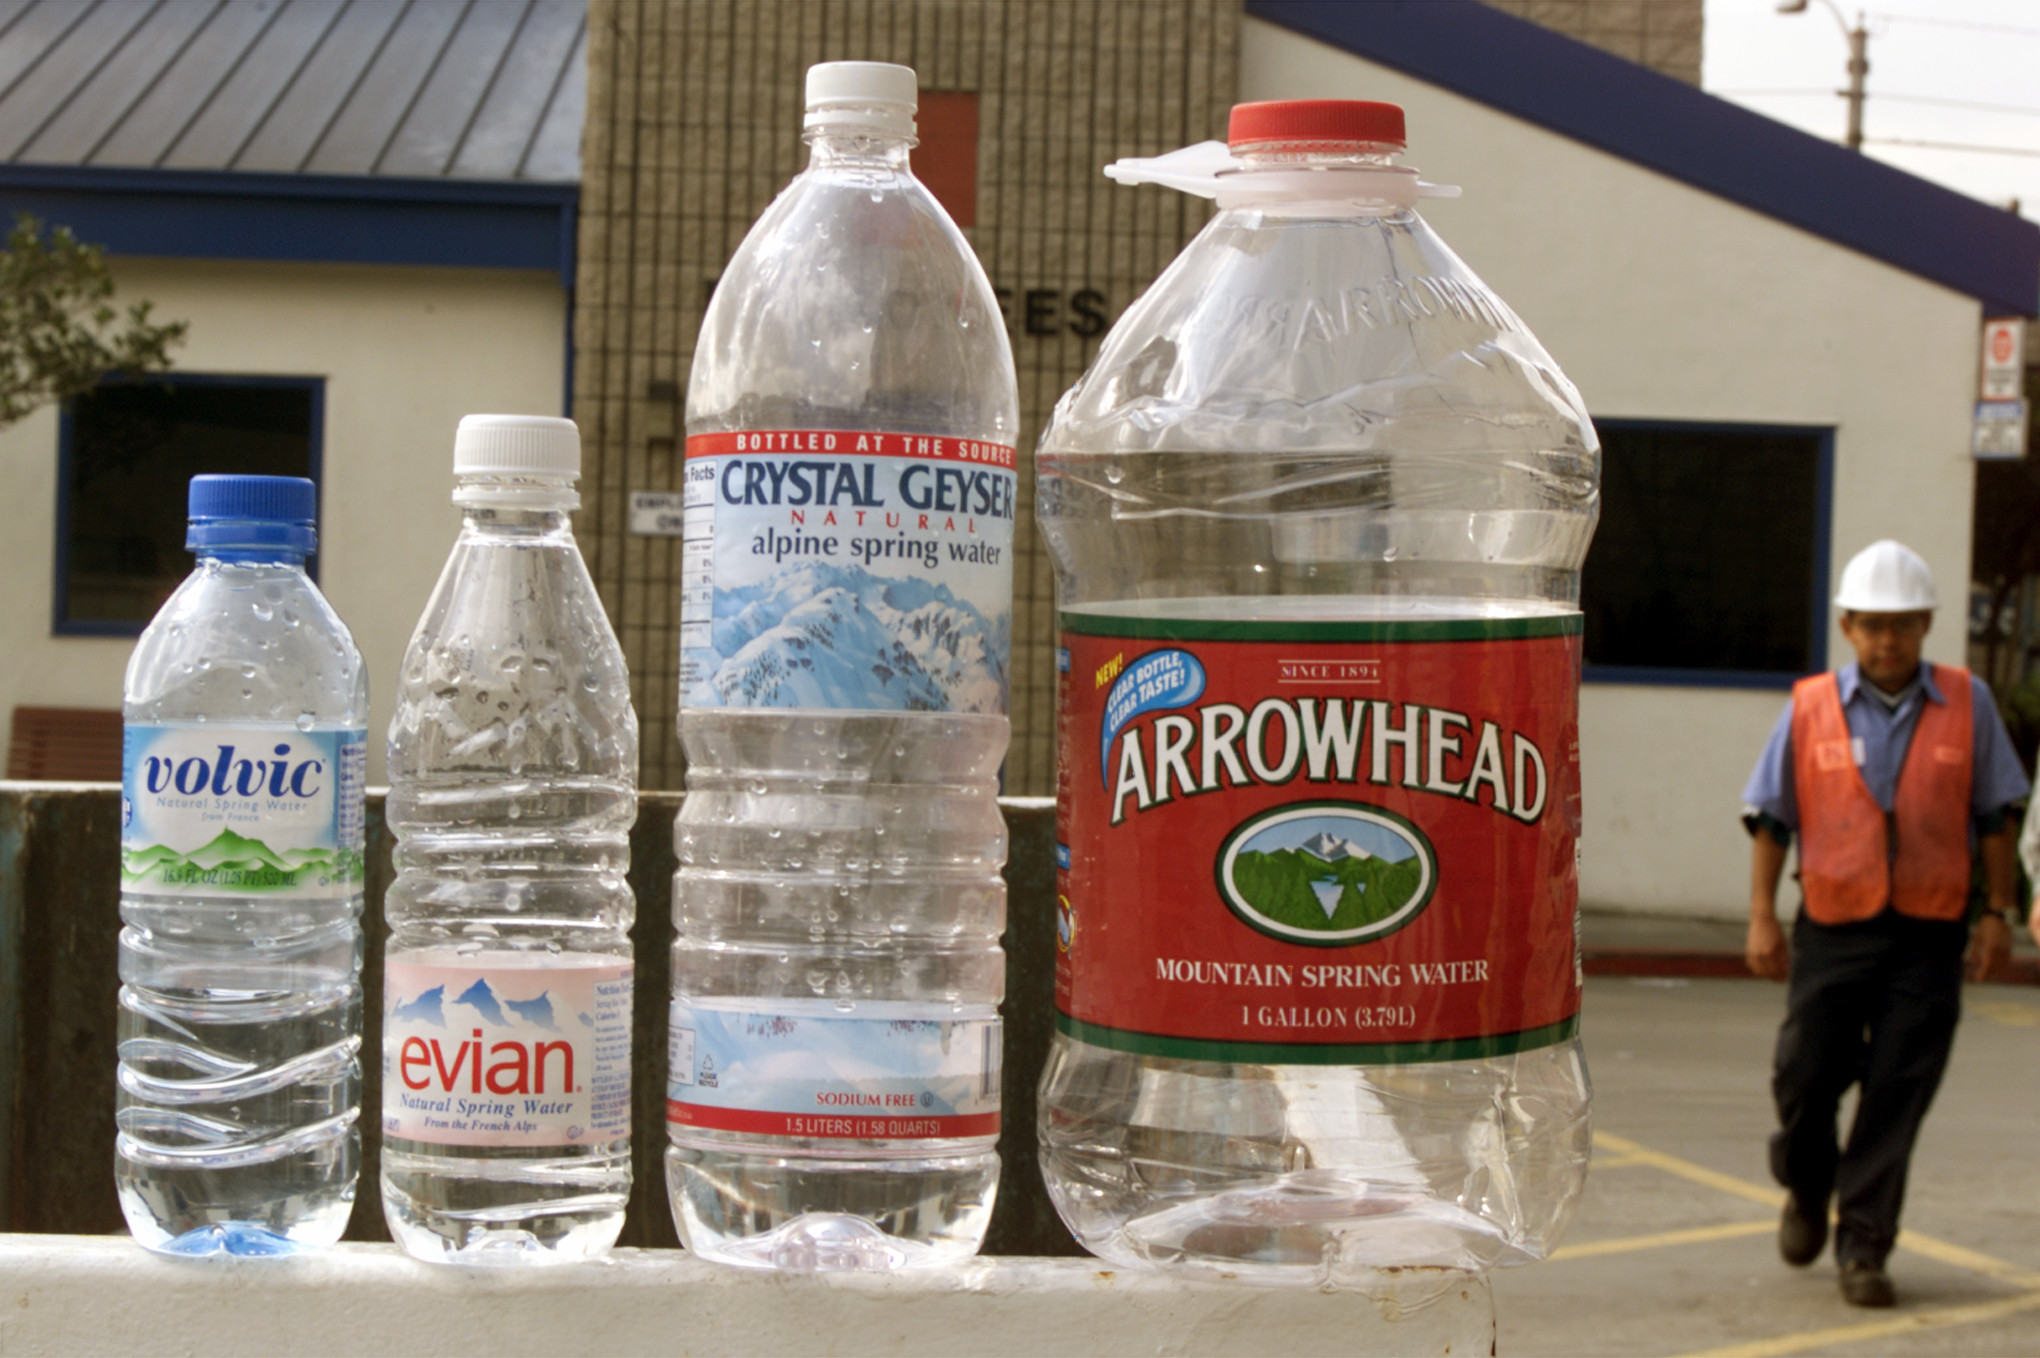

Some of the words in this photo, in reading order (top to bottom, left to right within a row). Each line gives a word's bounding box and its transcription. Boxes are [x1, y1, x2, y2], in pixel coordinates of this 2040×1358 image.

[736, 433, 837, 450] BOTTLED
[857, 435, 885, 452] AT
[903, 437, 943, 456] THE
[959, 441, 1012, 465] SOURCE
[690, 465, 715, 482] Facts
[721, 460, 885, 508] CRYSTAL
[898, 463, 1013, 521] GEYSER
[791, 509, 976, 534] NATURAL
[751, 527, 839, 563] alpine
[850, 531, 938, 568] spring
[948, 540, 1001, 566] water
[1095, 652, 1123, 689] NEW!
[1107, 674, 1135, 713] CLEAR
[1136, 651, 1183, 684] BOTTLE,
[1281, 665, 1330, 677] SINCE
[1109, 692, 1138, 732] CLEAR
[1138, 668, 1186, 704] TASTE!
[144, 743, 323, 798] volvic
[1110, 696, 1549, 828] ARROWHEAD
[157, 796, 208, 809] Natural
[214, 798, 259, 813] Spring
[266, 799, 308, 812] Water
[201, 811, 225, 823] from
[227, 812, 260, 822] France
[184, 869, 200, 884] FL
[202, 869, 218, 885] OZ
[1156, 958, 1294, 986] MOUNTAIN
[1301, 964, 1401, 988] SPRING
[1410, 959, 1490, 985] WATER
[1241, 1005, 1250, 1026] 1
[1258, 1006, 1349, 1028] GALLON
[1355, 1004, 1417, 1029] (3.79L)
[400, 1028, 574, 1096] evian
[400, 1093, 450, 1113] Natural
[457, 1099, 515, 1118] Spring
[524, 1099, 574, 1115] Water
[816, 1091, 881, 1107] SODIUM
[885, 1093, 916, 1107] FREE
[424, 1117, 451, 1130] From
[452, 1118, 468, 1130] the
[470, 1119, 511, 1132] French
[513, 1120, 538, 1133] Alps
[786, 1117, 803, 1133] 1.5
[807, 1118, 852, 1135] LITERS
[856, 1120, 885, 1136] (1.58
[889, 1120, 941, 1136] QUARTS)
